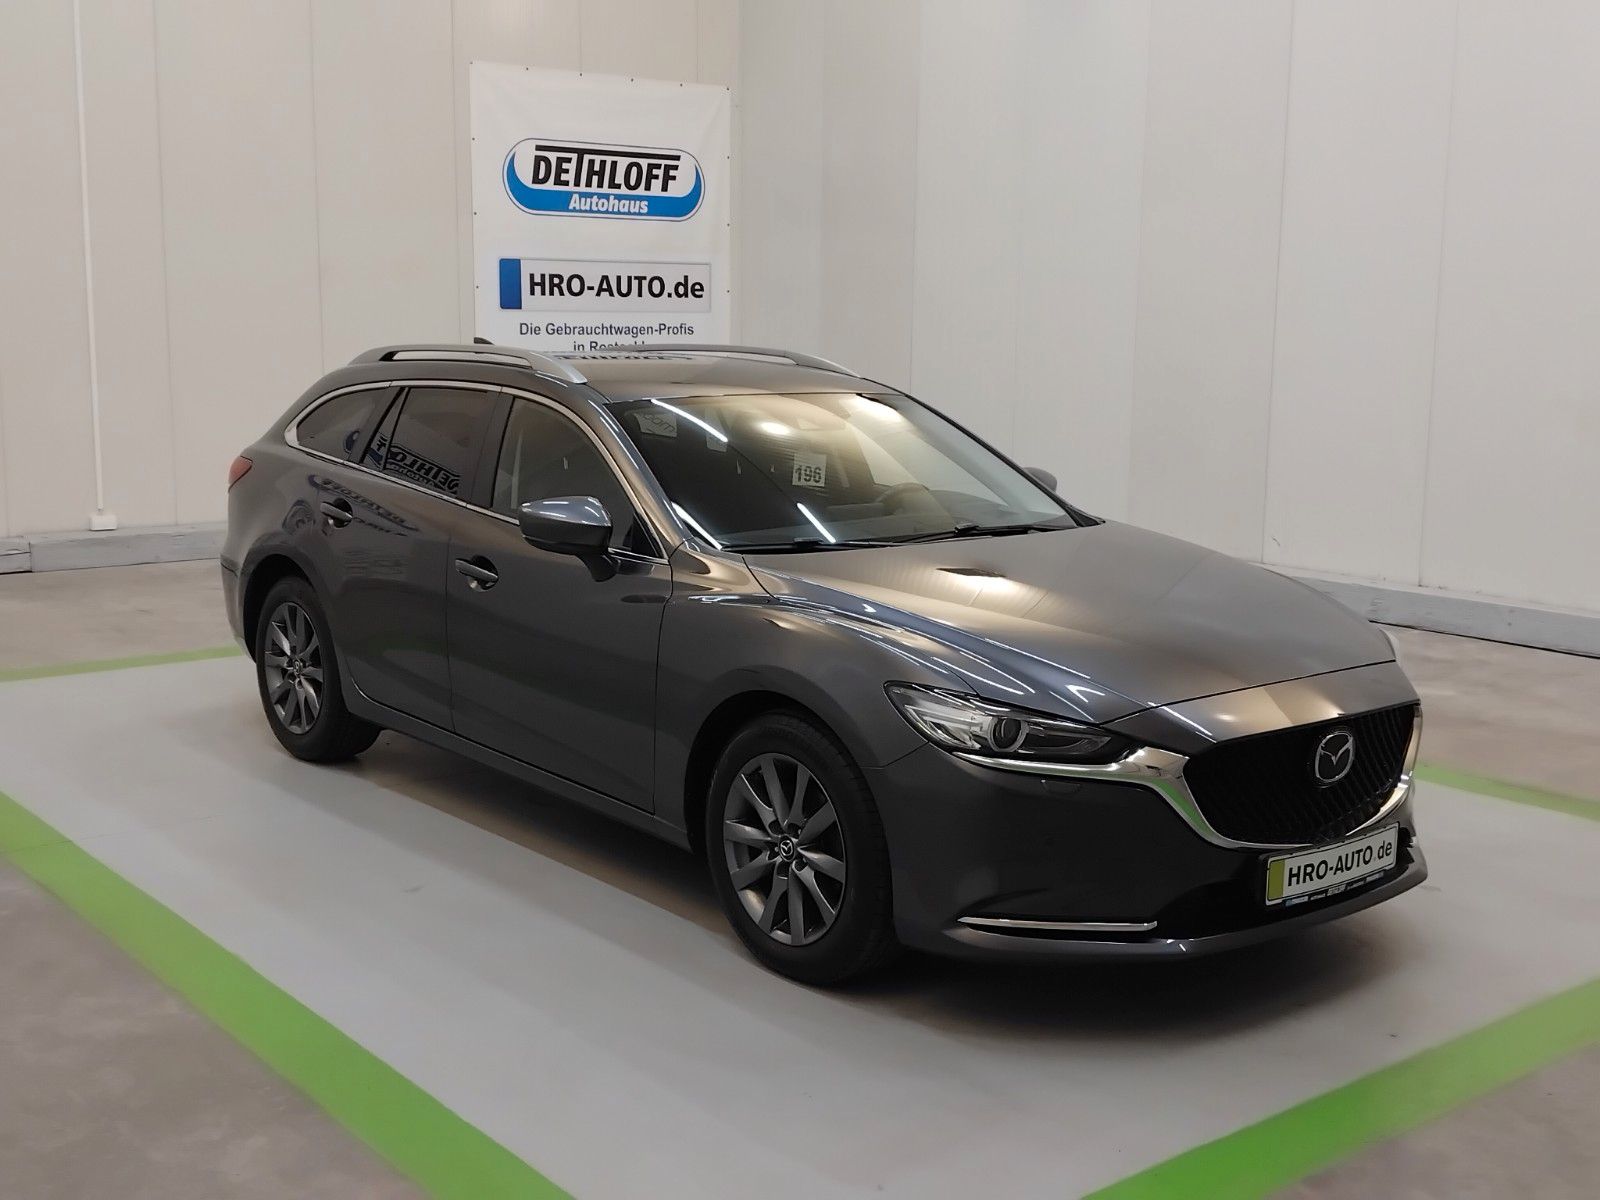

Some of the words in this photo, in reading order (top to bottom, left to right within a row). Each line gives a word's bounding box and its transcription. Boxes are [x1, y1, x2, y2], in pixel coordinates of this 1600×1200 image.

[531, 144, 681, 193] DETHLOFF
[568, 193, 648, 214] Autohaus
[528, 272, 705, 299] HRO-AUTO.de
[519, 322, 541, 335] Die
[545, 322, 695, 338] Gebrauchtwagen-Profis
[573, 341, 585, 351] in
[794, 464, 822, 484] 196
